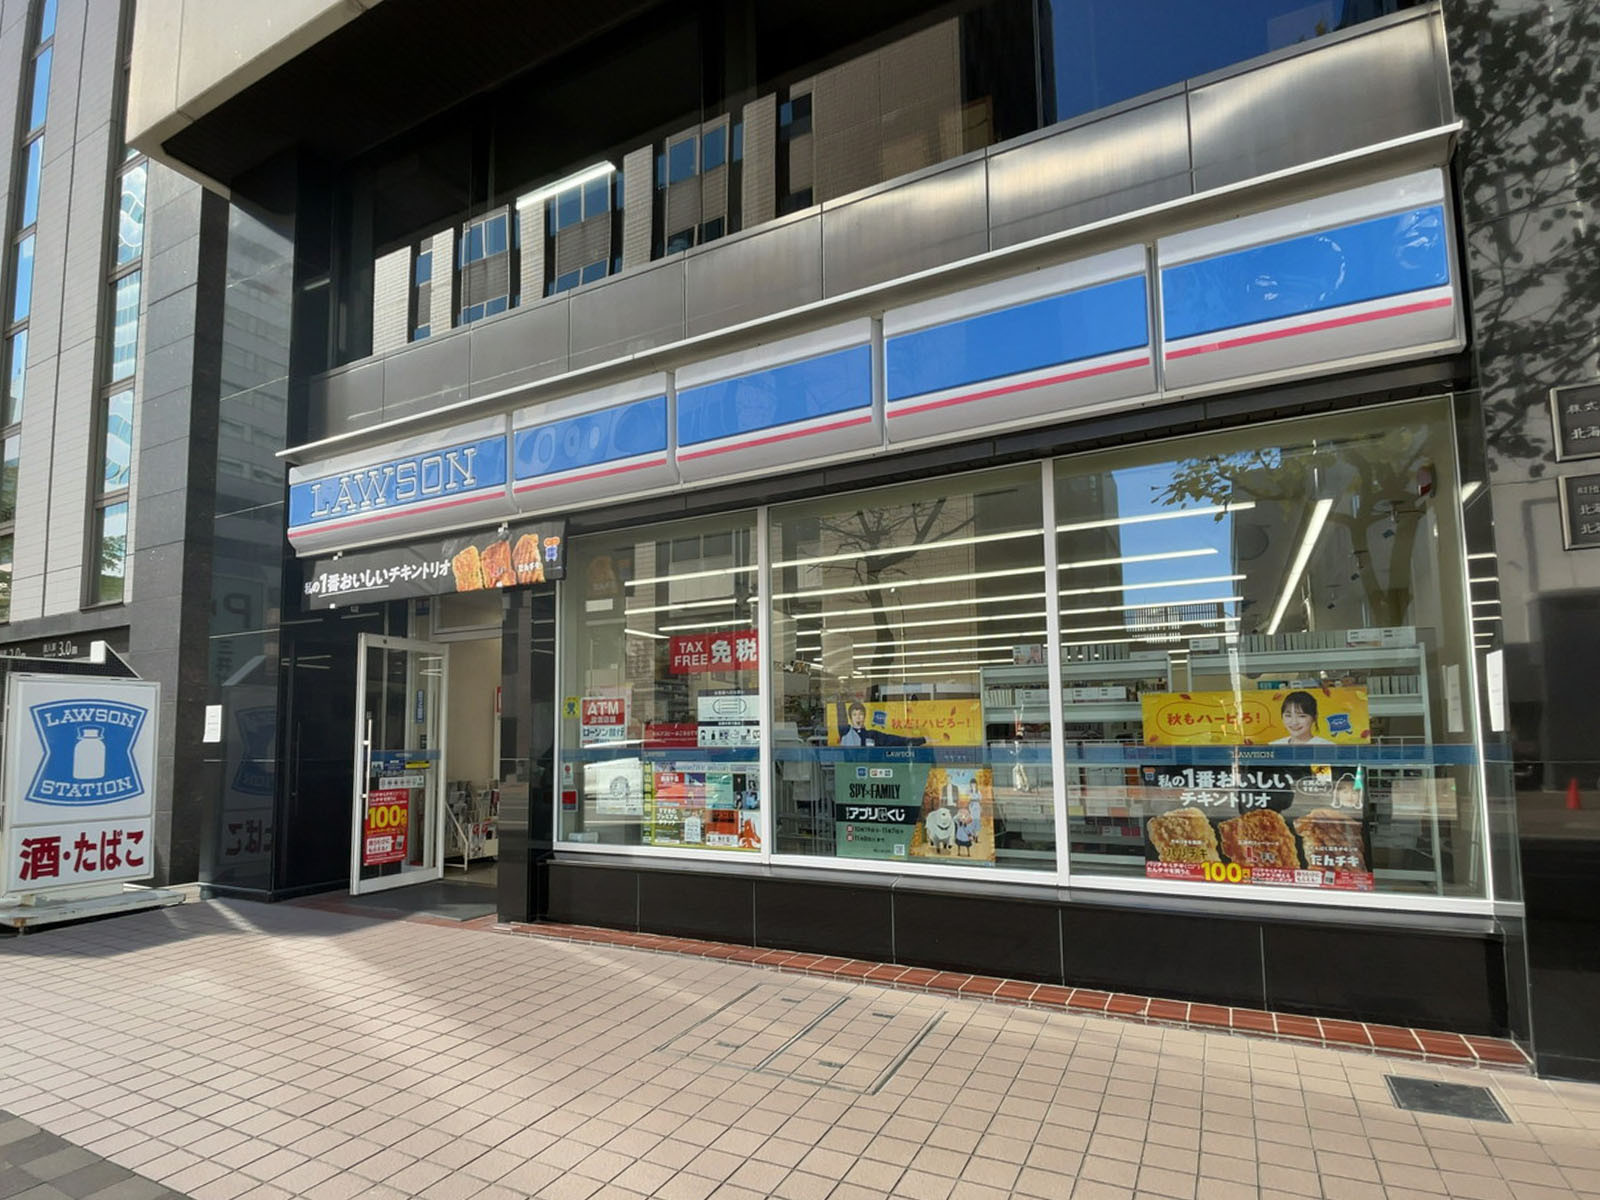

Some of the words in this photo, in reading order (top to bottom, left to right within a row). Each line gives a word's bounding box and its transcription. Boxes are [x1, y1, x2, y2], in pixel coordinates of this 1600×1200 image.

[310, 447, 478, 519] LAWSON
[678, 641, 704, 654] TAX
[710, 639, 758, 664] 免税
[674, 654, 709, 667] FREE
[45, 707, 138, 728] LAWSON
[587, 701, 619, 716] ATM
[40, 775, 134, 799] STATION
[1157, 768, 1294, 790] 私の1番おいしい
[1179, 791, 1272, 808] チキントリオ
[19, 829, 145, 881] 酒・たばこ
